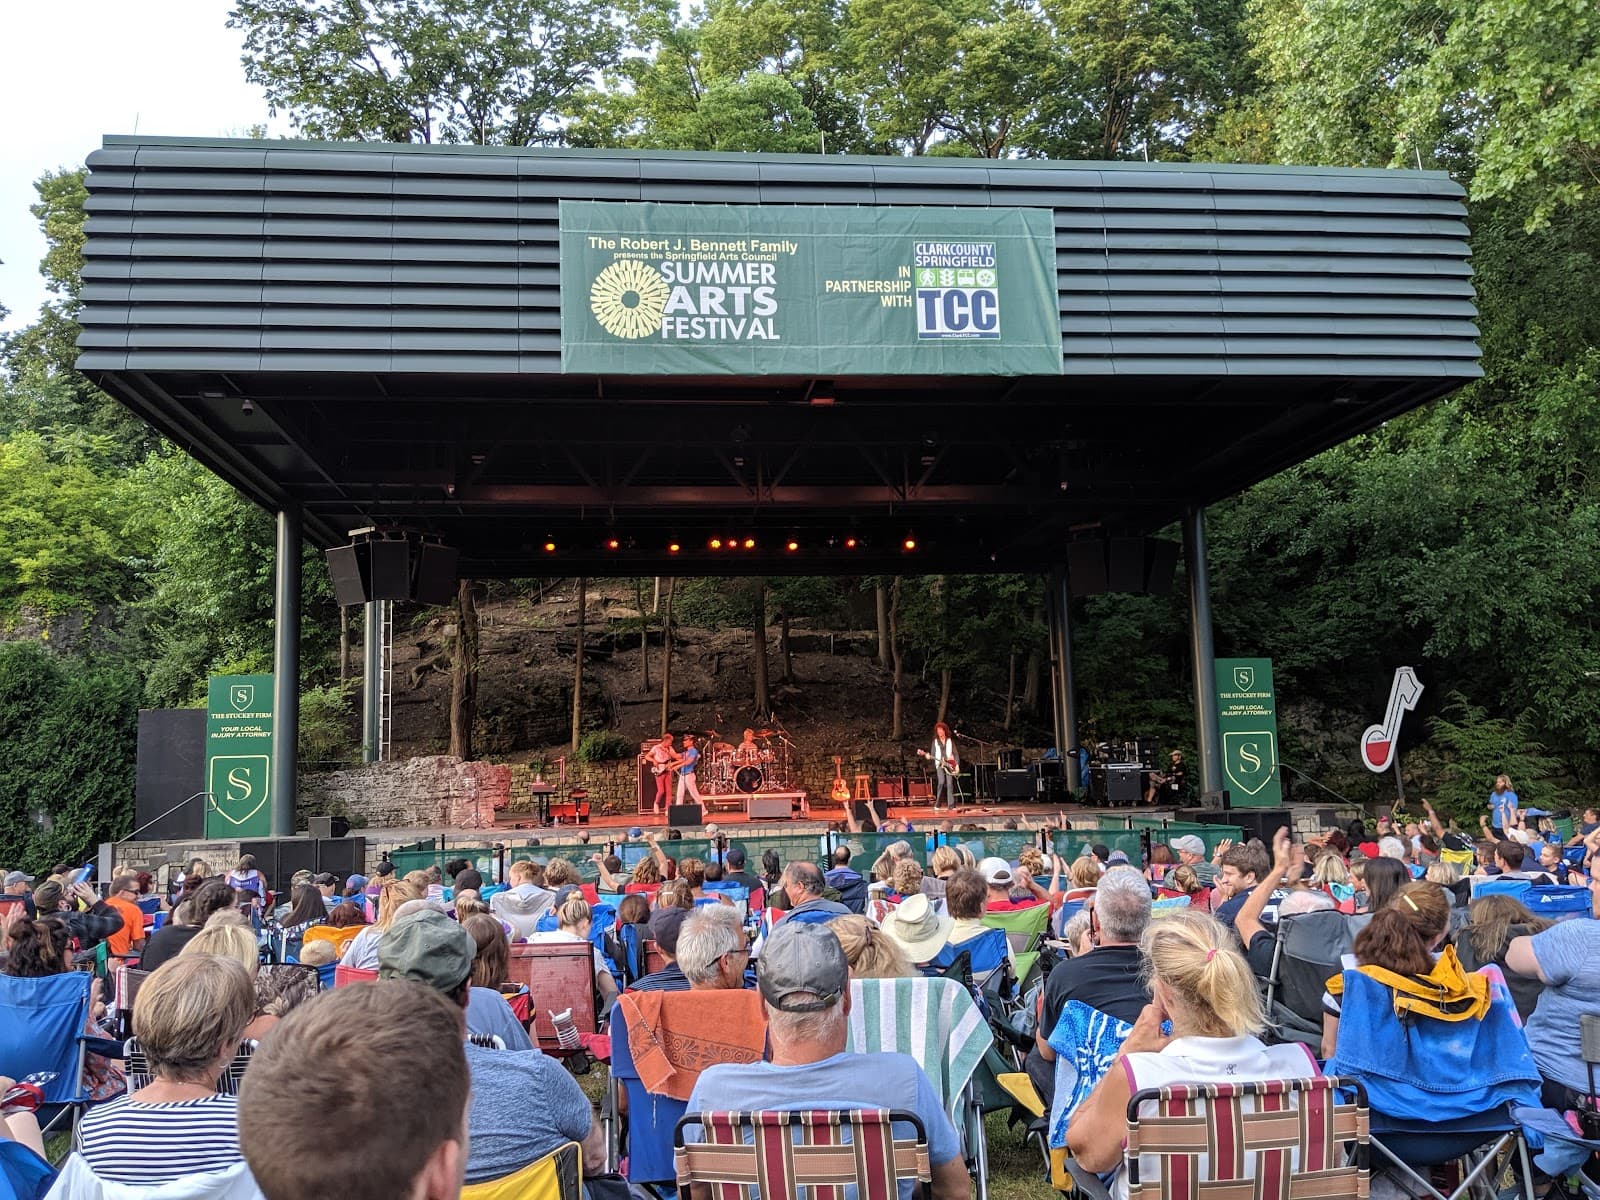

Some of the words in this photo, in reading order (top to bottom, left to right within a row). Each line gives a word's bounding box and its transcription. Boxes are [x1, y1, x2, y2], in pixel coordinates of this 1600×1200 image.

[588, 236, 616, 249] The
[620, 238, 670, 251] Robert
[673, 239, 685, 251] J.
[690, 239, 748, 252] Bennett
[751, 240, 798, 255] Family
[613, 252, 648, 261] presents
[650, 252, 663, 260] the
[665, 252, 717, 262] Springfield
[719, 252, 739, 261] Arts
[741, 252, 777, 262] Council
[915, 256, 995, 267] SPRINGFIELD
[660, 261, 777, 285] SUMMER
[898, 266, 911, 278] IN
[825, 280, 912, 293] PARTNERSHIP
[662, 286, 778, 316] ARTS
[880, 295, 912, 308] WITH
[918, 289, 997, 331] TCC
[660, 317, 781, 341] FESTIVAL
[1239, 671, 1249, 684] S
[236, 689, 248, 703] S
[1239, 742, 1261, 773] S
[226, 767, 252, 801] S
